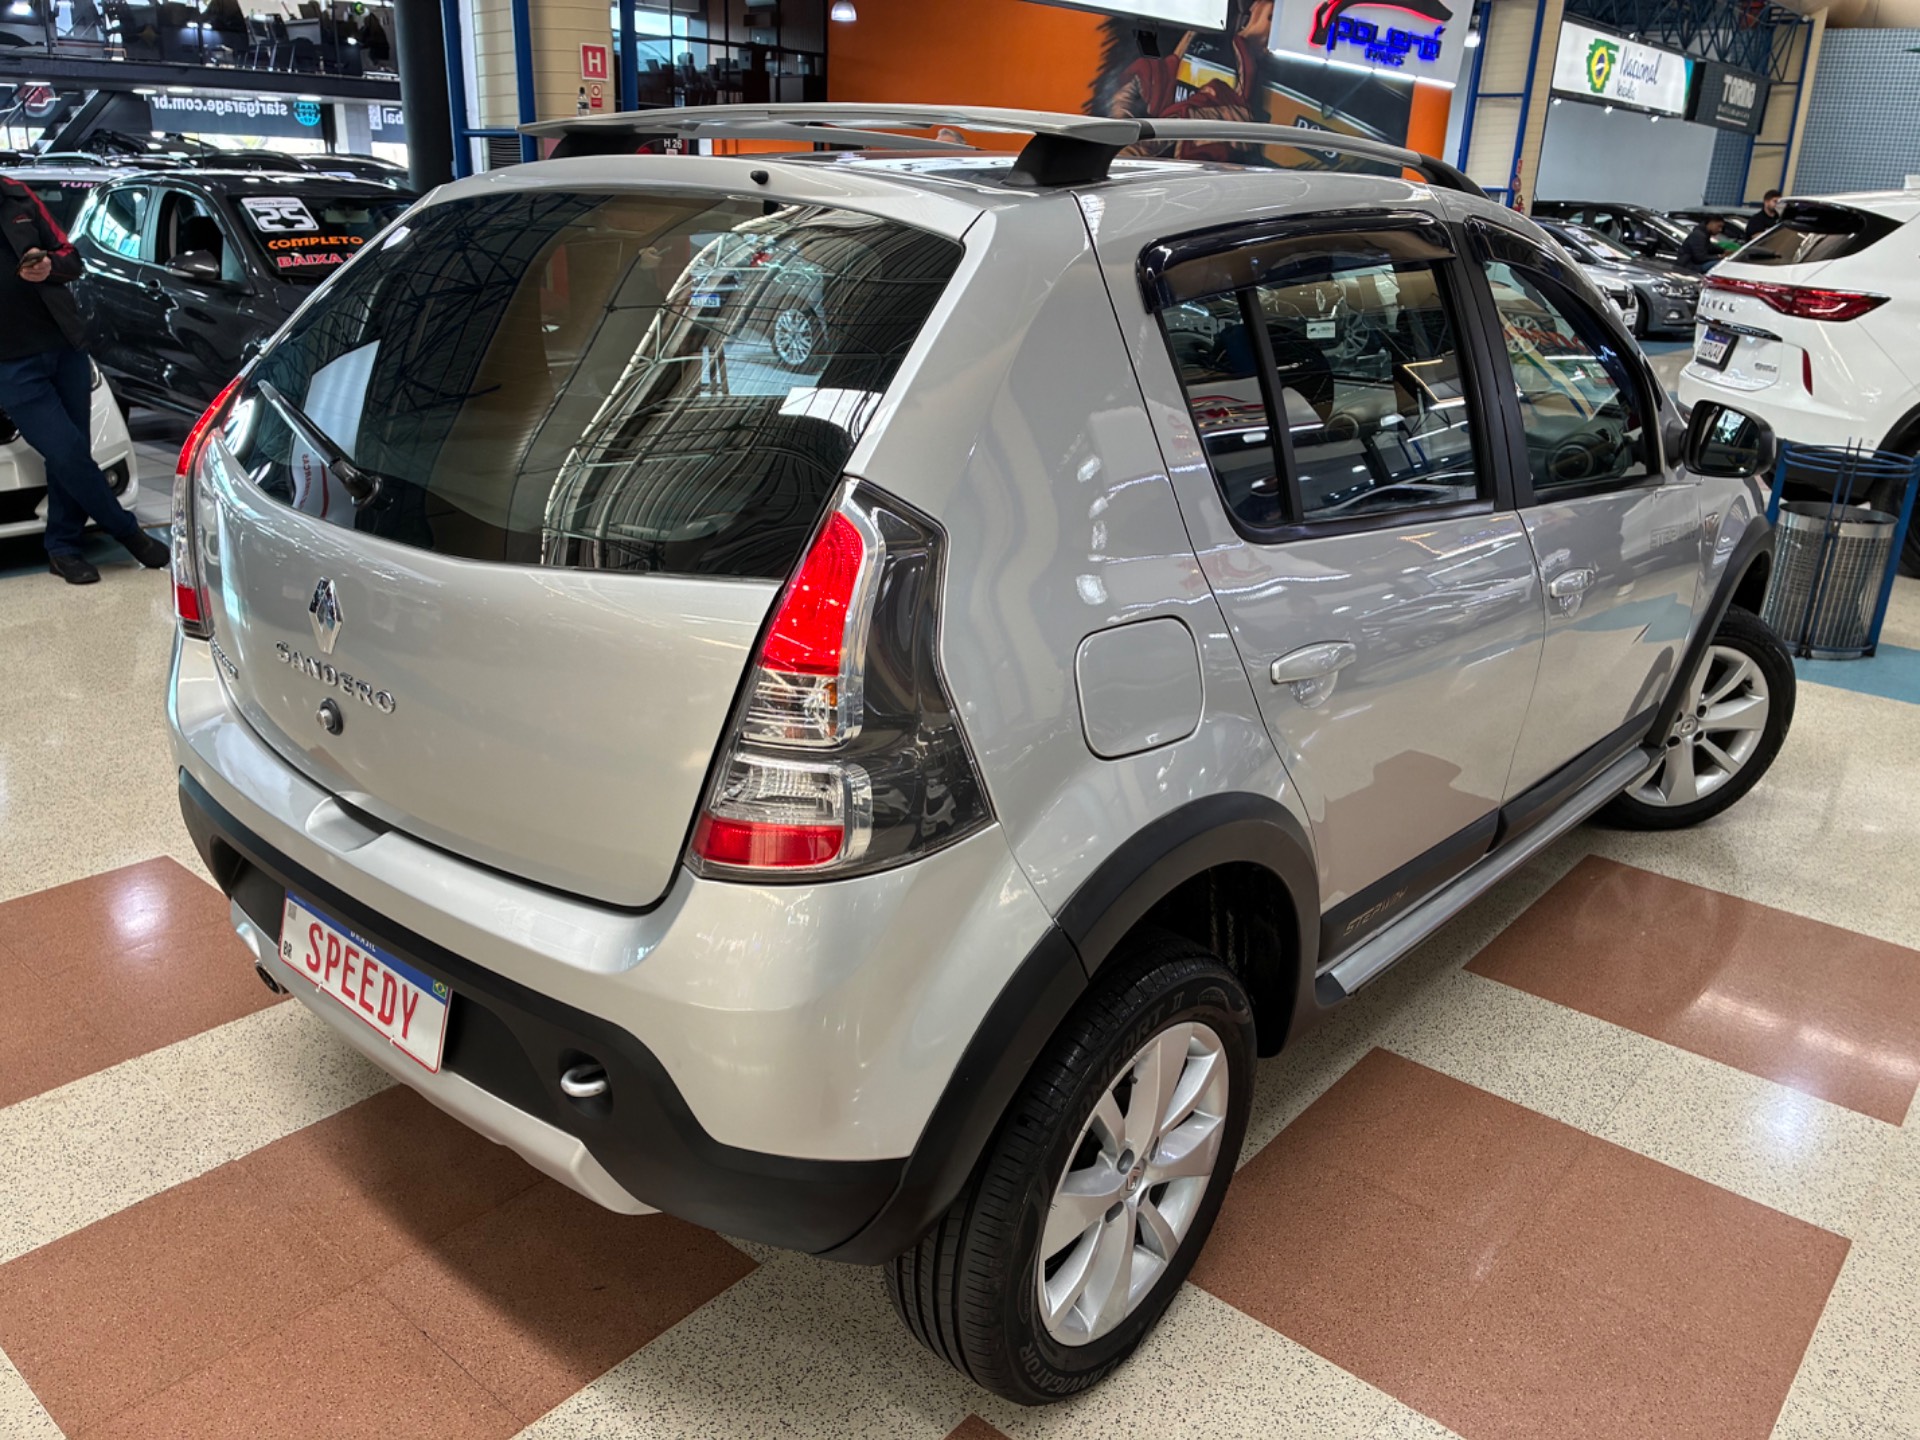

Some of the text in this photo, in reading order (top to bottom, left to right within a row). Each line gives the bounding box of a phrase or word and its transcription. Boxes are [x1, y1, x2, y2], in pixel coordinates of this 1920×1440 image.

[587, 51, 602, 73] H
[267, 235, 364, 250] COMPLETO
[277, 252, 344, 268] BAIXA
[276, 640, 396, 714] SANDERO
[283, 939, 293, 960] BR
[306, 922, 419, 1040] SPEEDY
